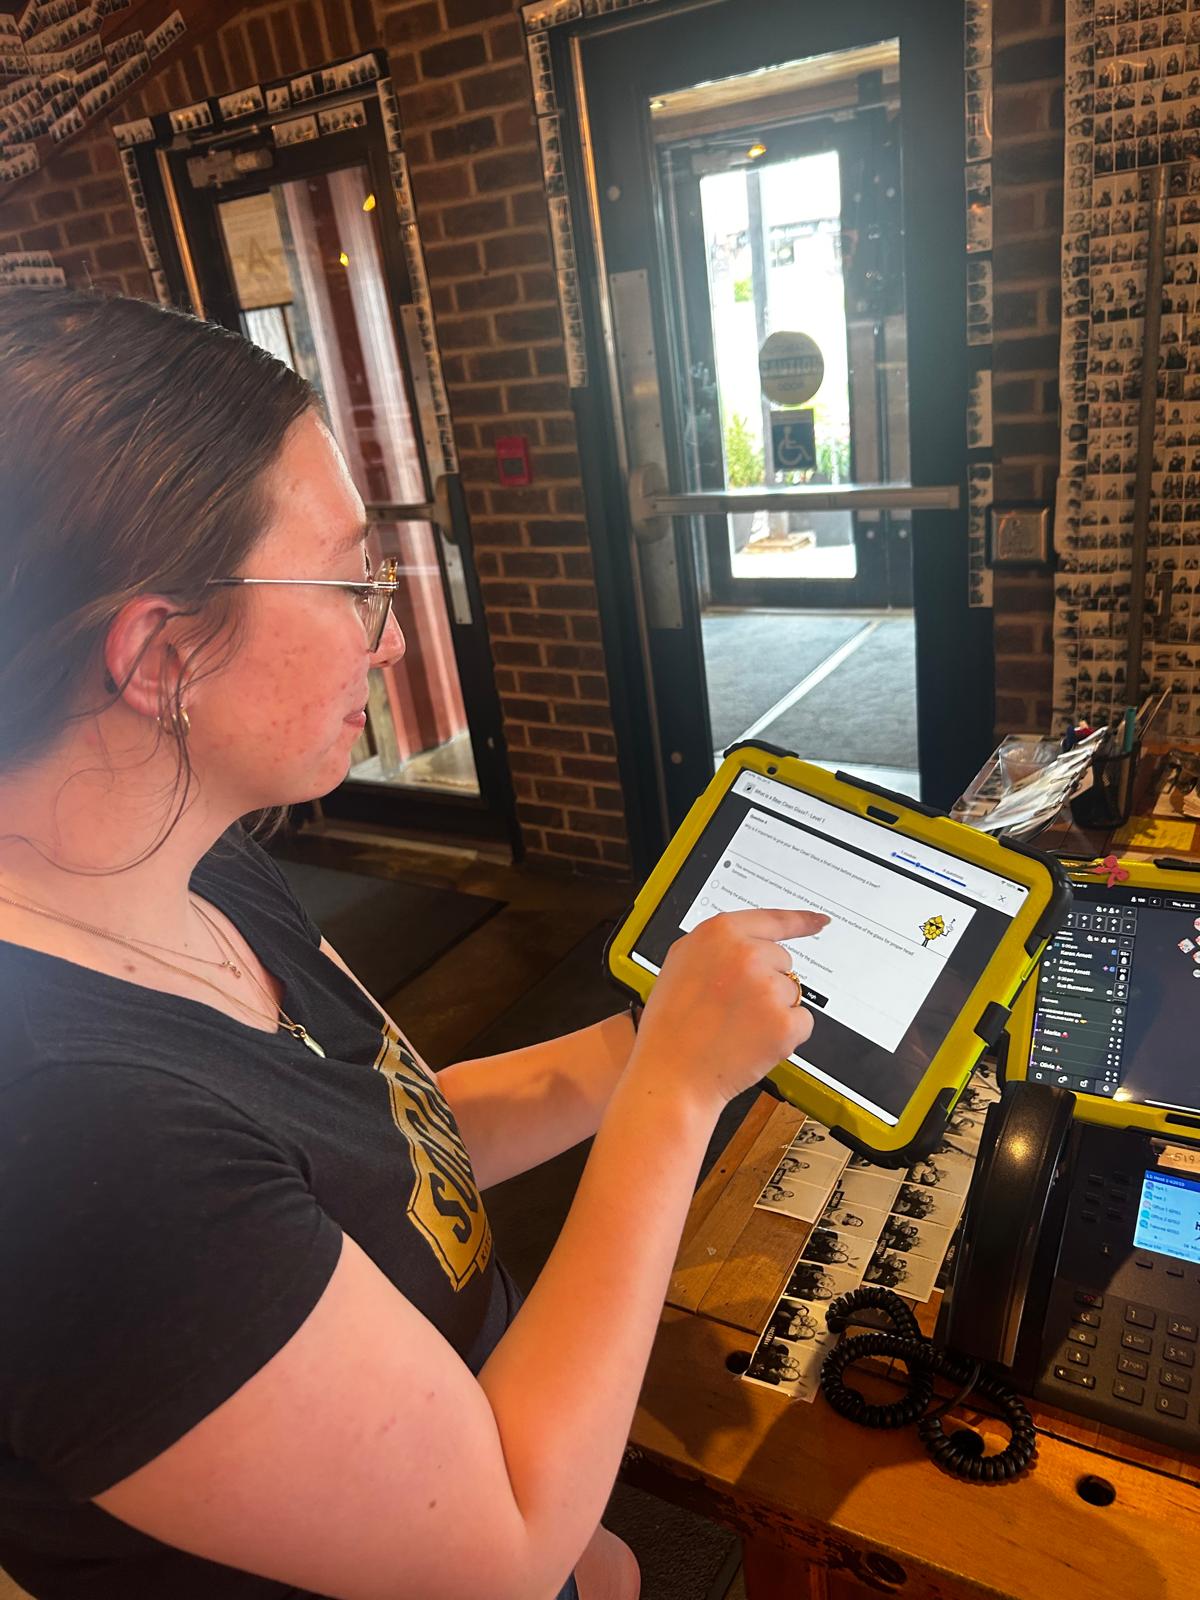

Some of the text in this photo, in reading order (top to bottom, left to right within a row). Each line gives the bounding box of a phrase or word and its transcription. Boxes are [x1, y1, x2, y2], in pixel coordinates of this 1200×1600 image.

[810, 813, 821, 822] Level
[1131, 1311, 1135, 1319] 1
[1172, 1323, 1178, 1332] 2
[1169, 1347, 1176, 1356] 5
[1122, 1359, 1129, 1368] 7
[1165, 1372, 1171, 1382] 8
[1161, 1399, 1168, 1408] 0
